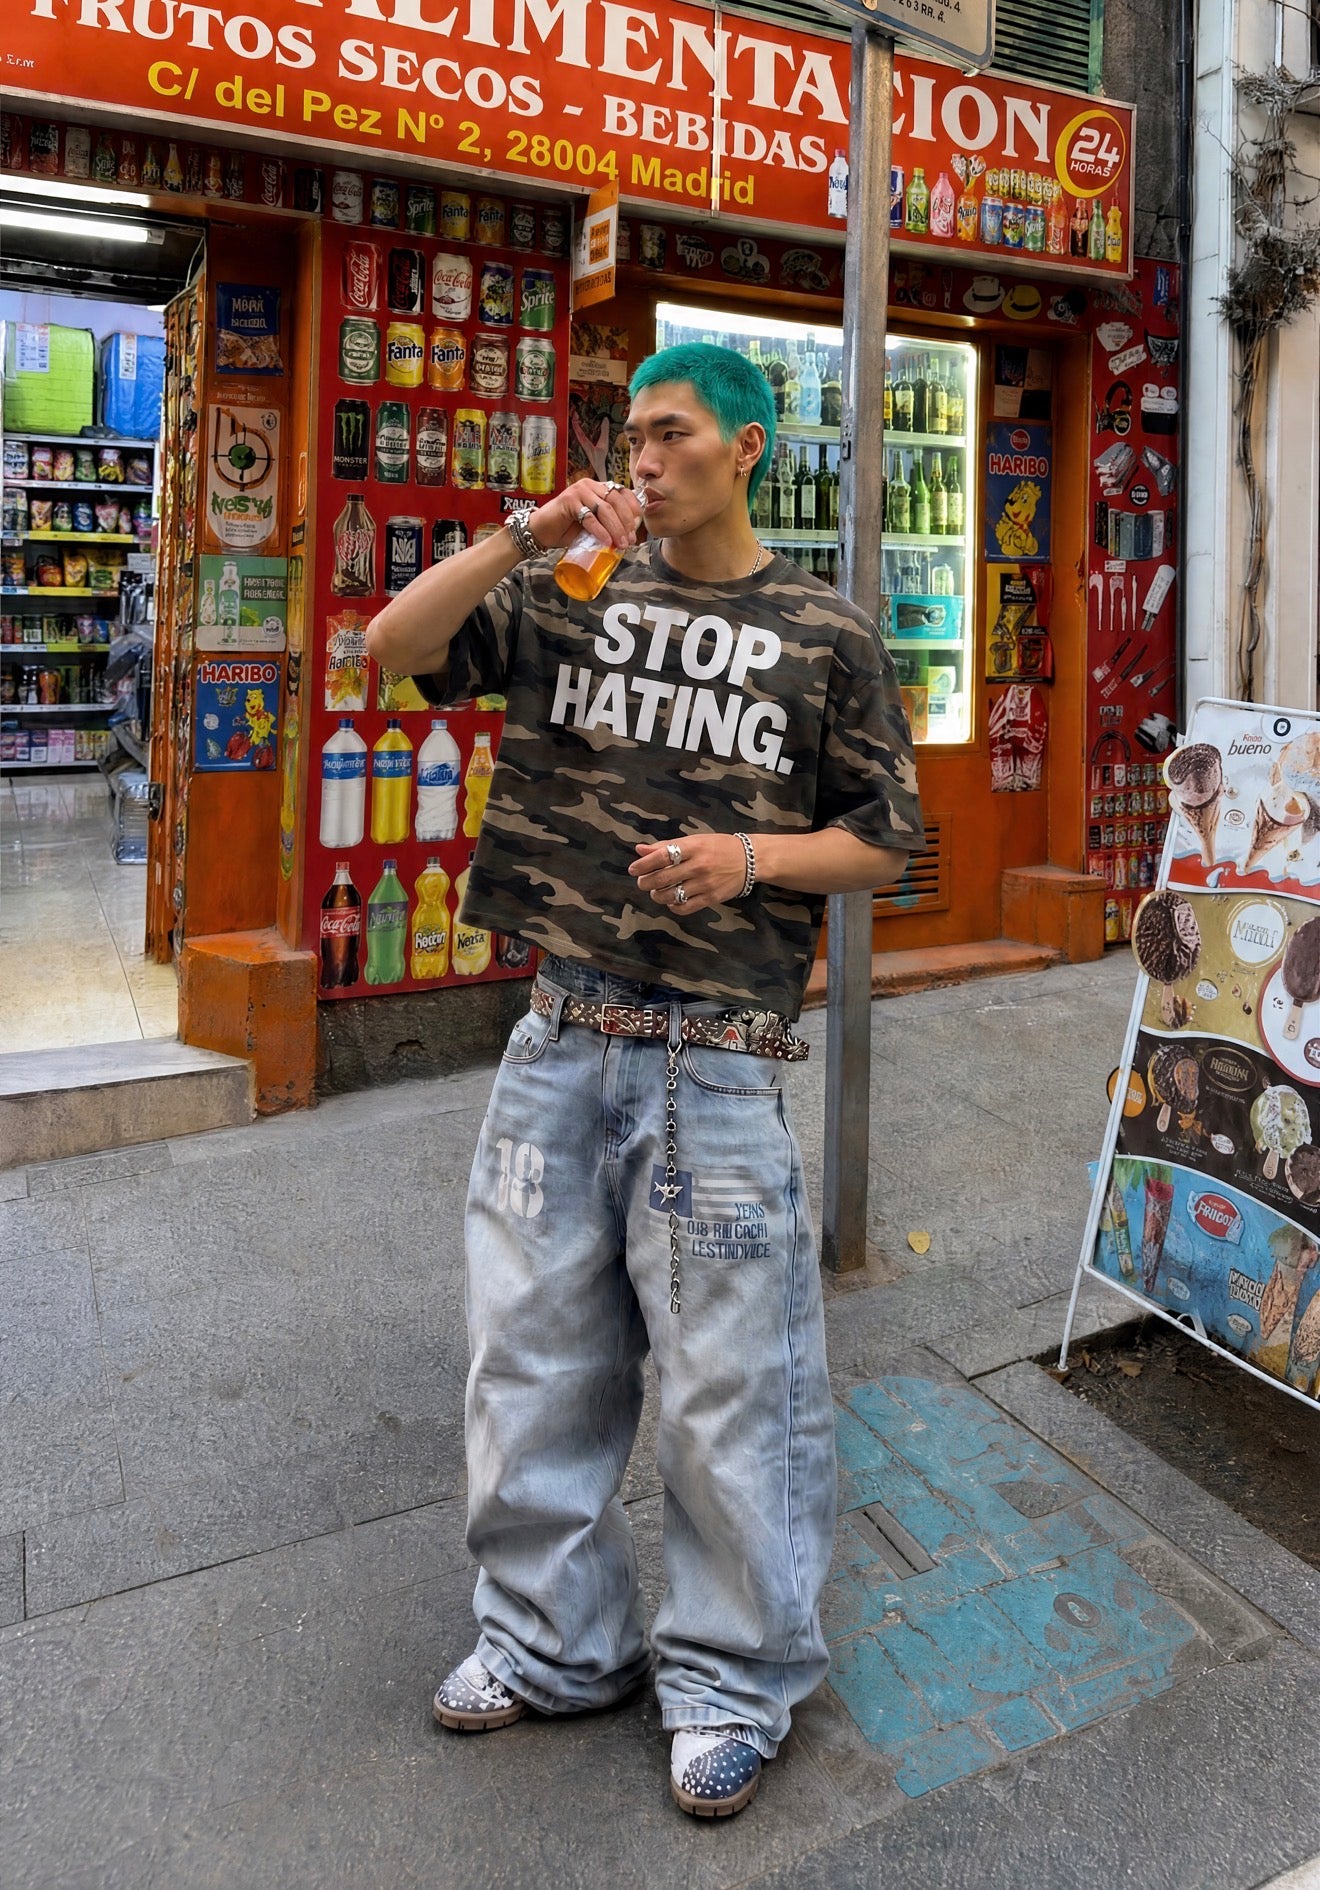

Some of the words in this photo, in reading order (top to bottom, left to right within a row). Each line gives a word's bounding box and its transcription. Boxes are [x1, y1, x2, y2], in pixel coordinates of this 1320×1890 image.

[295, 0, 1051, 164] LIMENTAION
[339, 39, 543, 117] SECOS
[603, 94, 828, 174] BEBIDAS
[148, 61, 199, 99] C/
[216, 76, 284, 117] del
[303, 90, 382, 135] Pez
[458, 121, 492, 162] 2,
[506, 130, 619, 181] 28004
[632, 154, 755, 205] Madrid
[1070, 127, 1120, 168] 24
[1070, 161, 1112, 177] HORAS
[442, 204, 469, 219] Fanta
[520, 289, 555, 312] Sprite
[387, 341, 423, 362] Fanta
[431, 344, 465, 364] Fanta
[334, 455, 368, 465] MONSTER
[989, 453, 1049, 477] HARIBO
[594, 602, 782, 687] STOP
[201, 663, 277, 684] HARIBO
[550, 663, 795, 776] HATING.
[1227, 739, 1272, 756] bueno
